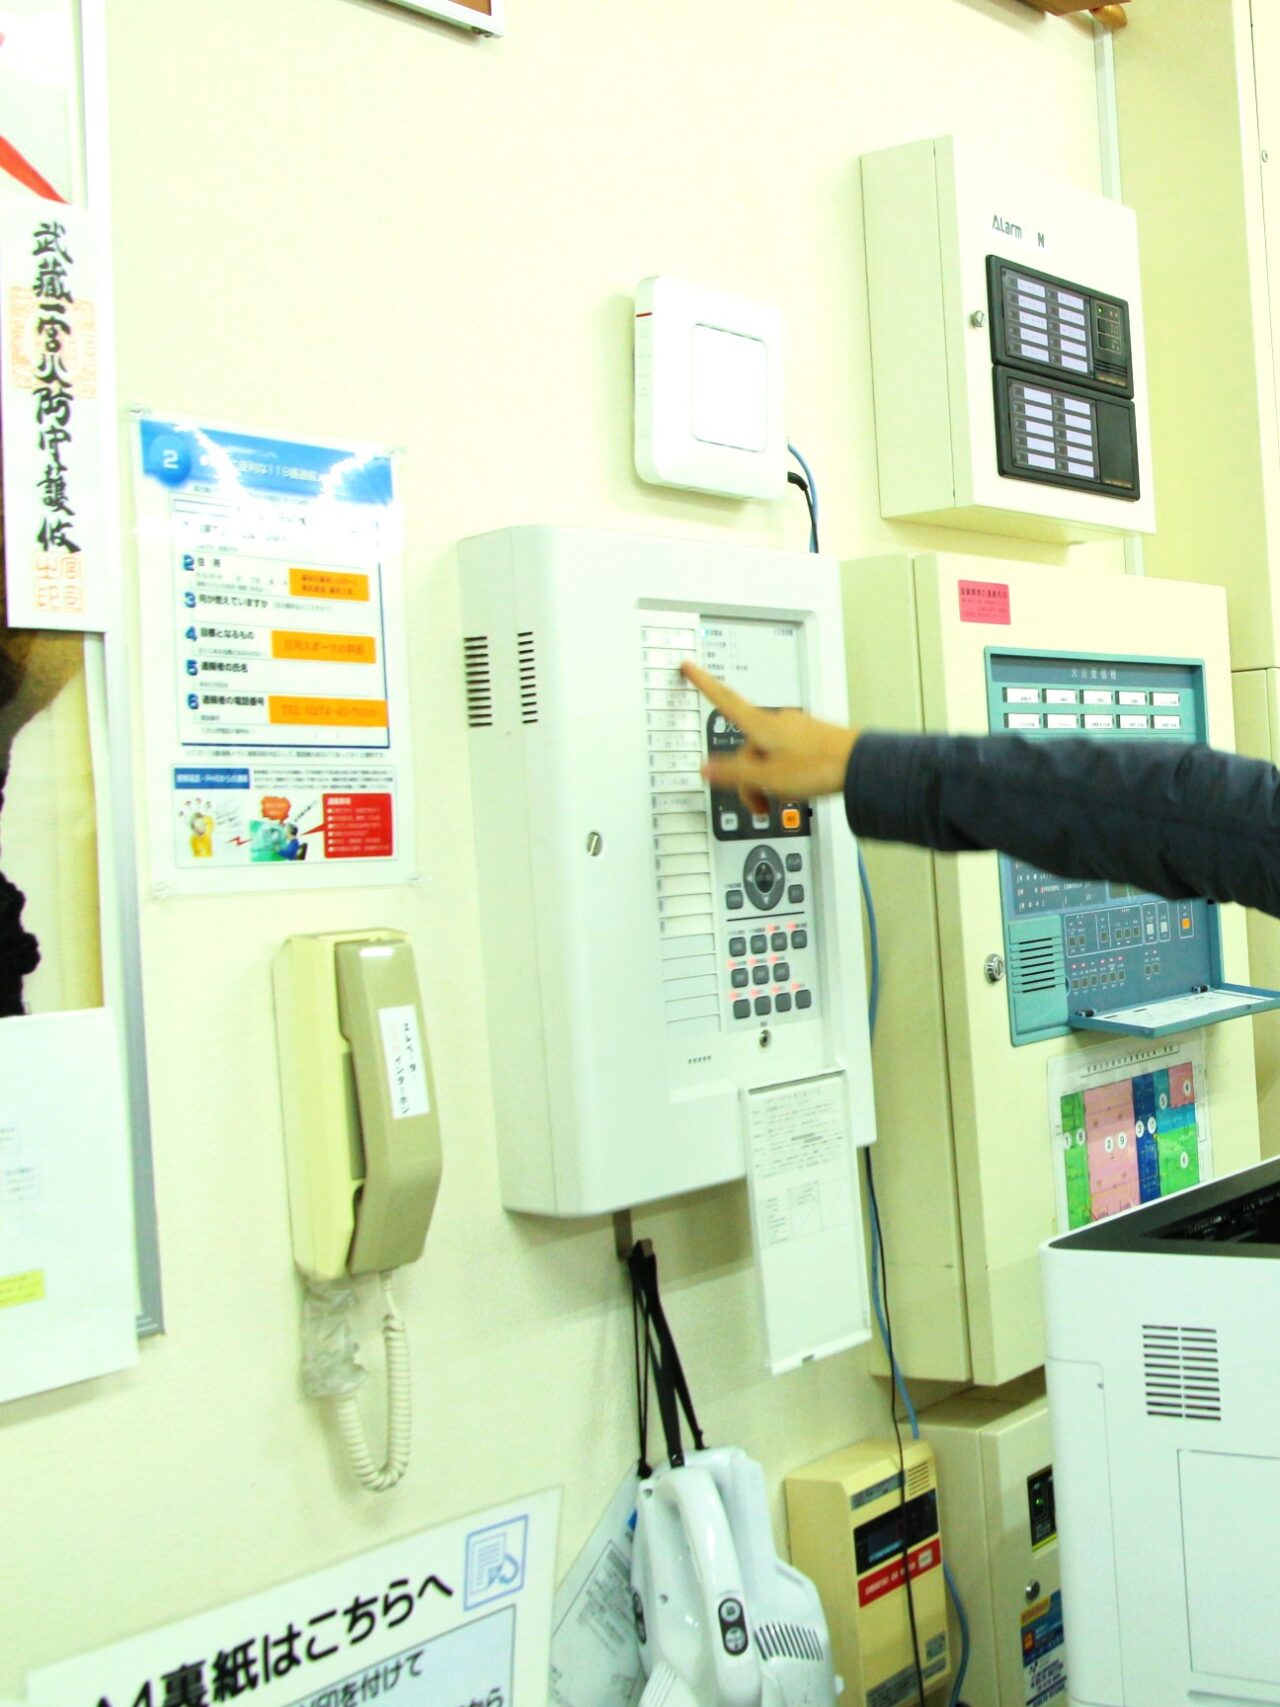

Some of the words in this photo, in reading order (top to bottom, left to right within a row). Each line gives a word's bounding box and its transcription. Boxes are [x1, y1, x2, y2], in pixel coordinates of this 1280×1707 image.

[162, 449, 179, 469] 2
[183, 554, 195, 571] 2
[184, 591, 196, 608] 3
[185, 626, 197, 642] 4
[187, 659, 198, 676] 5
[188, 693, 199, 710] 6
